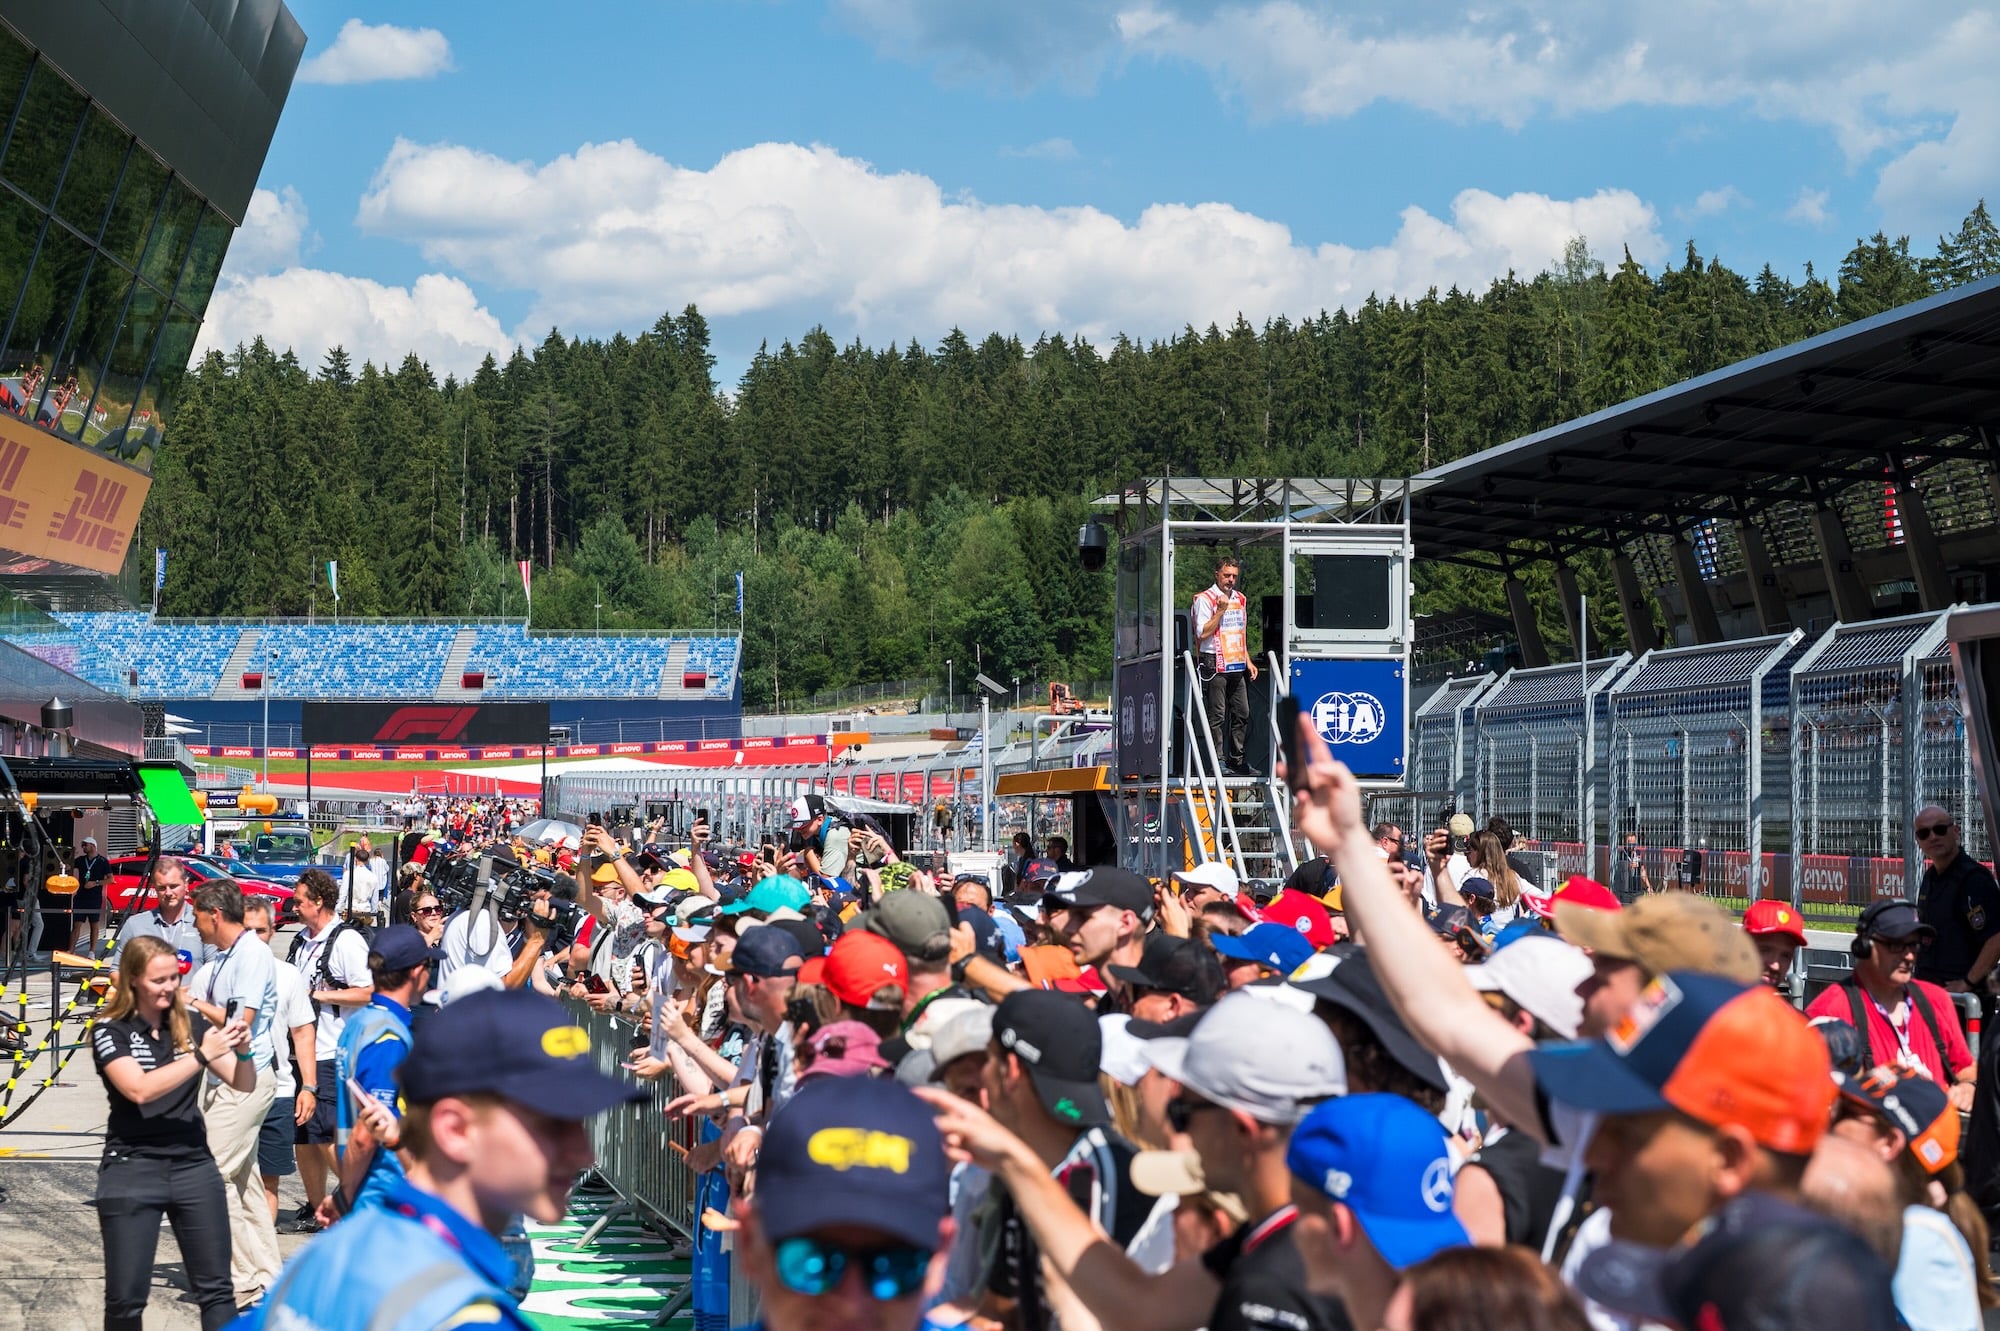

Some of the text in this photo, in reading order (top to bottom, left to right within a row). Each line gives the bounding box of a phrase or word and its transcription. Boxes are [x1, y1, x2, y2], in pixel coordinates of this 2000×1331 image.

[373, 707, 479, 740] F1
[701, 741, 728, 749] Lenovo
[744, 739, 771, 747] Lenovo
[788, 737, 815, 745] Lenovo
[570, 747, 597, 755] Lenovo
[614, 745, 641, 753] Lenovo
[657, 743, 685, 751] Lenovo
[224, 748, 251, 756] Lenovo
[268, 749, 295, 757] Lenovo
[440, 751, 467, 759] Lenovo
[483, 750, 510, 758] Lenovo
[527, 748, 554, 756] Lenvo
[40, 771, 85, 779] PETRONAS
[1728, 858, 1769, 888] Leno
[1802, 867, 1844, 892] enovo
